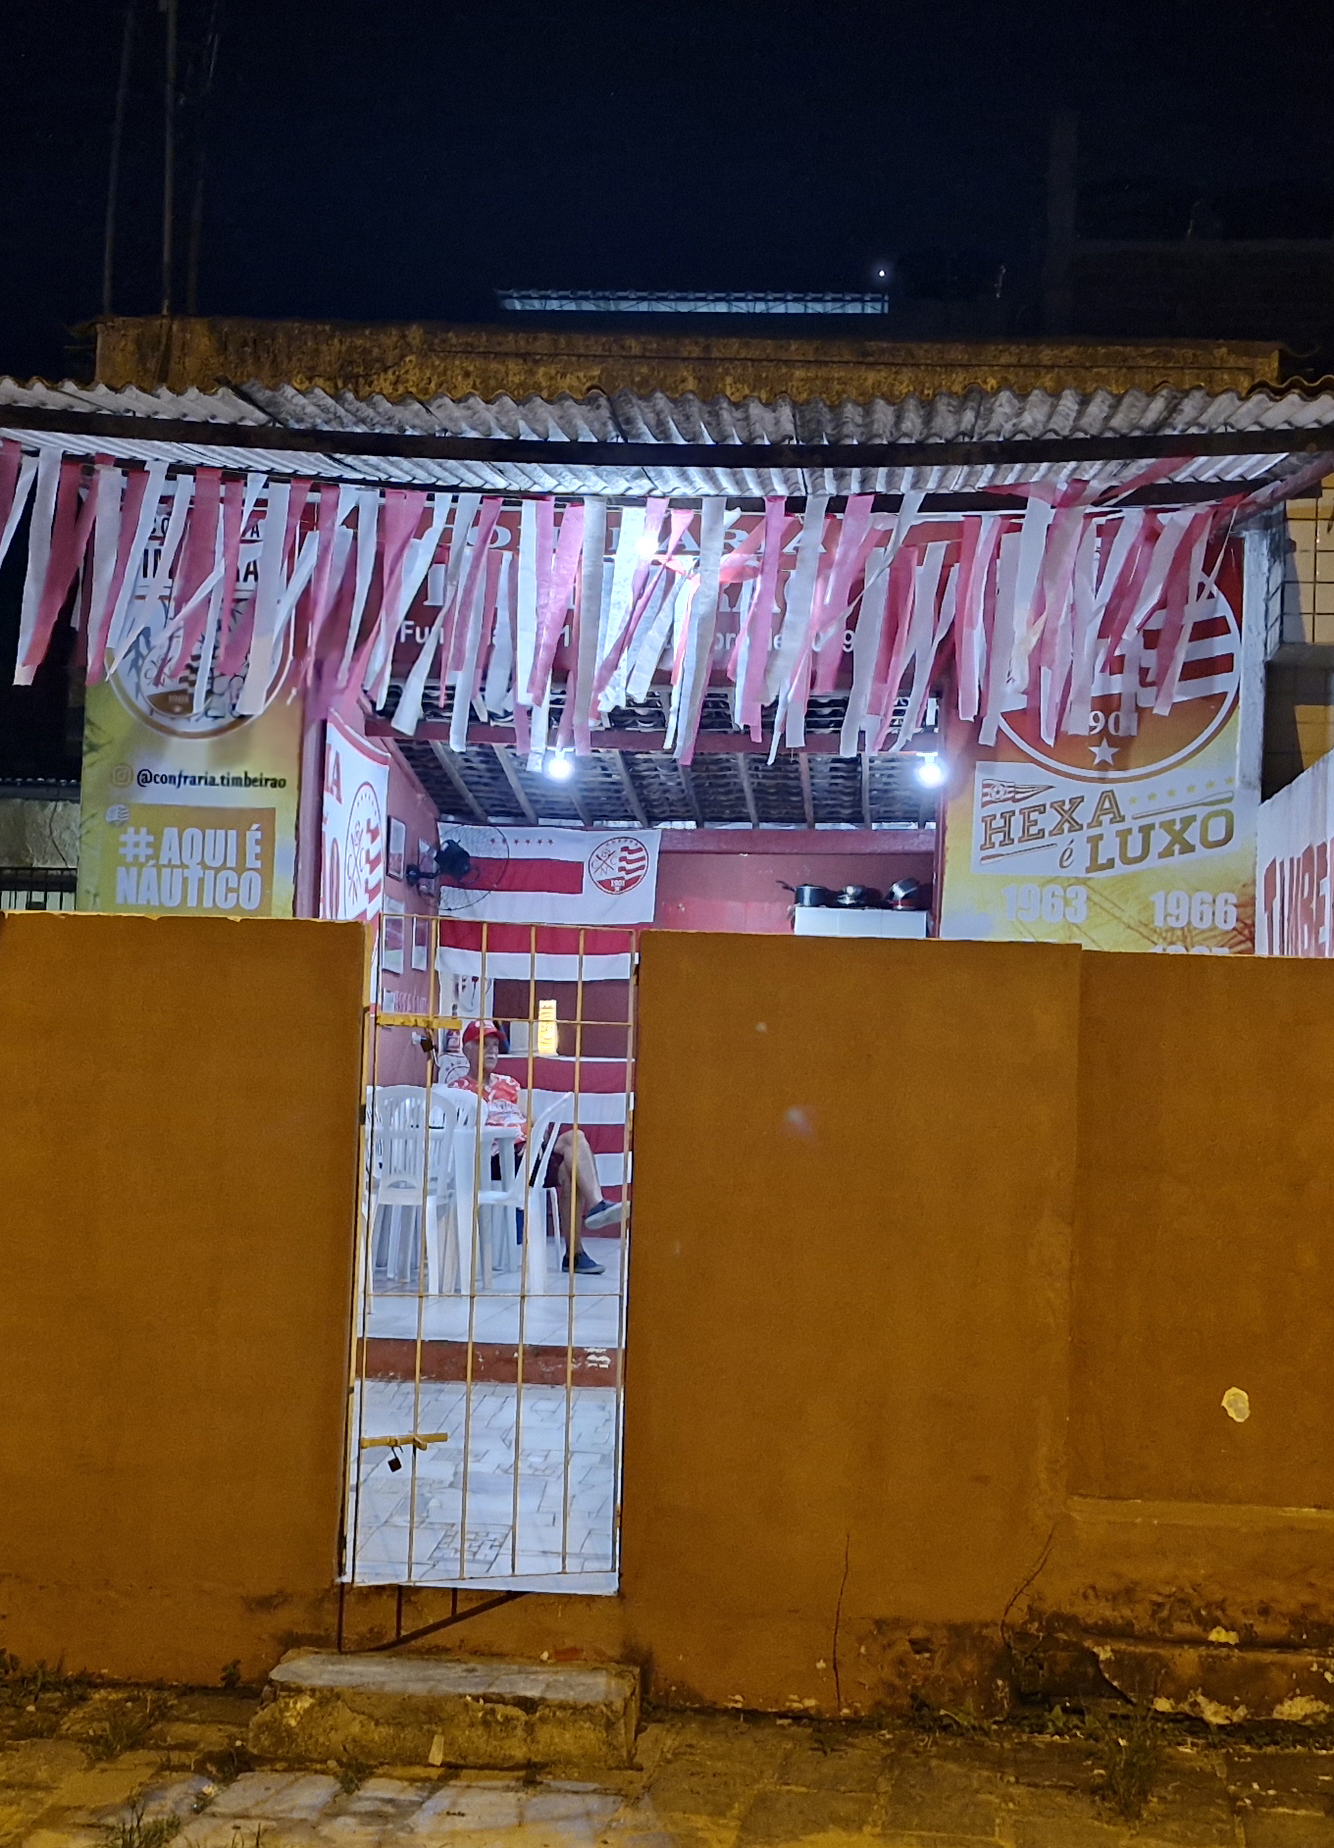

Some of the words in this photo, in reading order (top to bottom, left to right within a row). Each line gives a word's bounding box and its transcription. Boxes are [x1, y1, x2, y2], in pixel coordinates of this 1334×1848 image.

[137, 768, 287, 789] @confraria.timbeirao
[980, 789, 1125, 851] HEXA
[1059, 838, 1075, 869] é
[1085, 808, 1235, 874] LUXO
[245, 823, 263, 869] É
[116, 860, 263, 911] NÁUTICO
[1001, 883, 1088, 924] 1963
[1150, 890, 1238, 931] 1966
